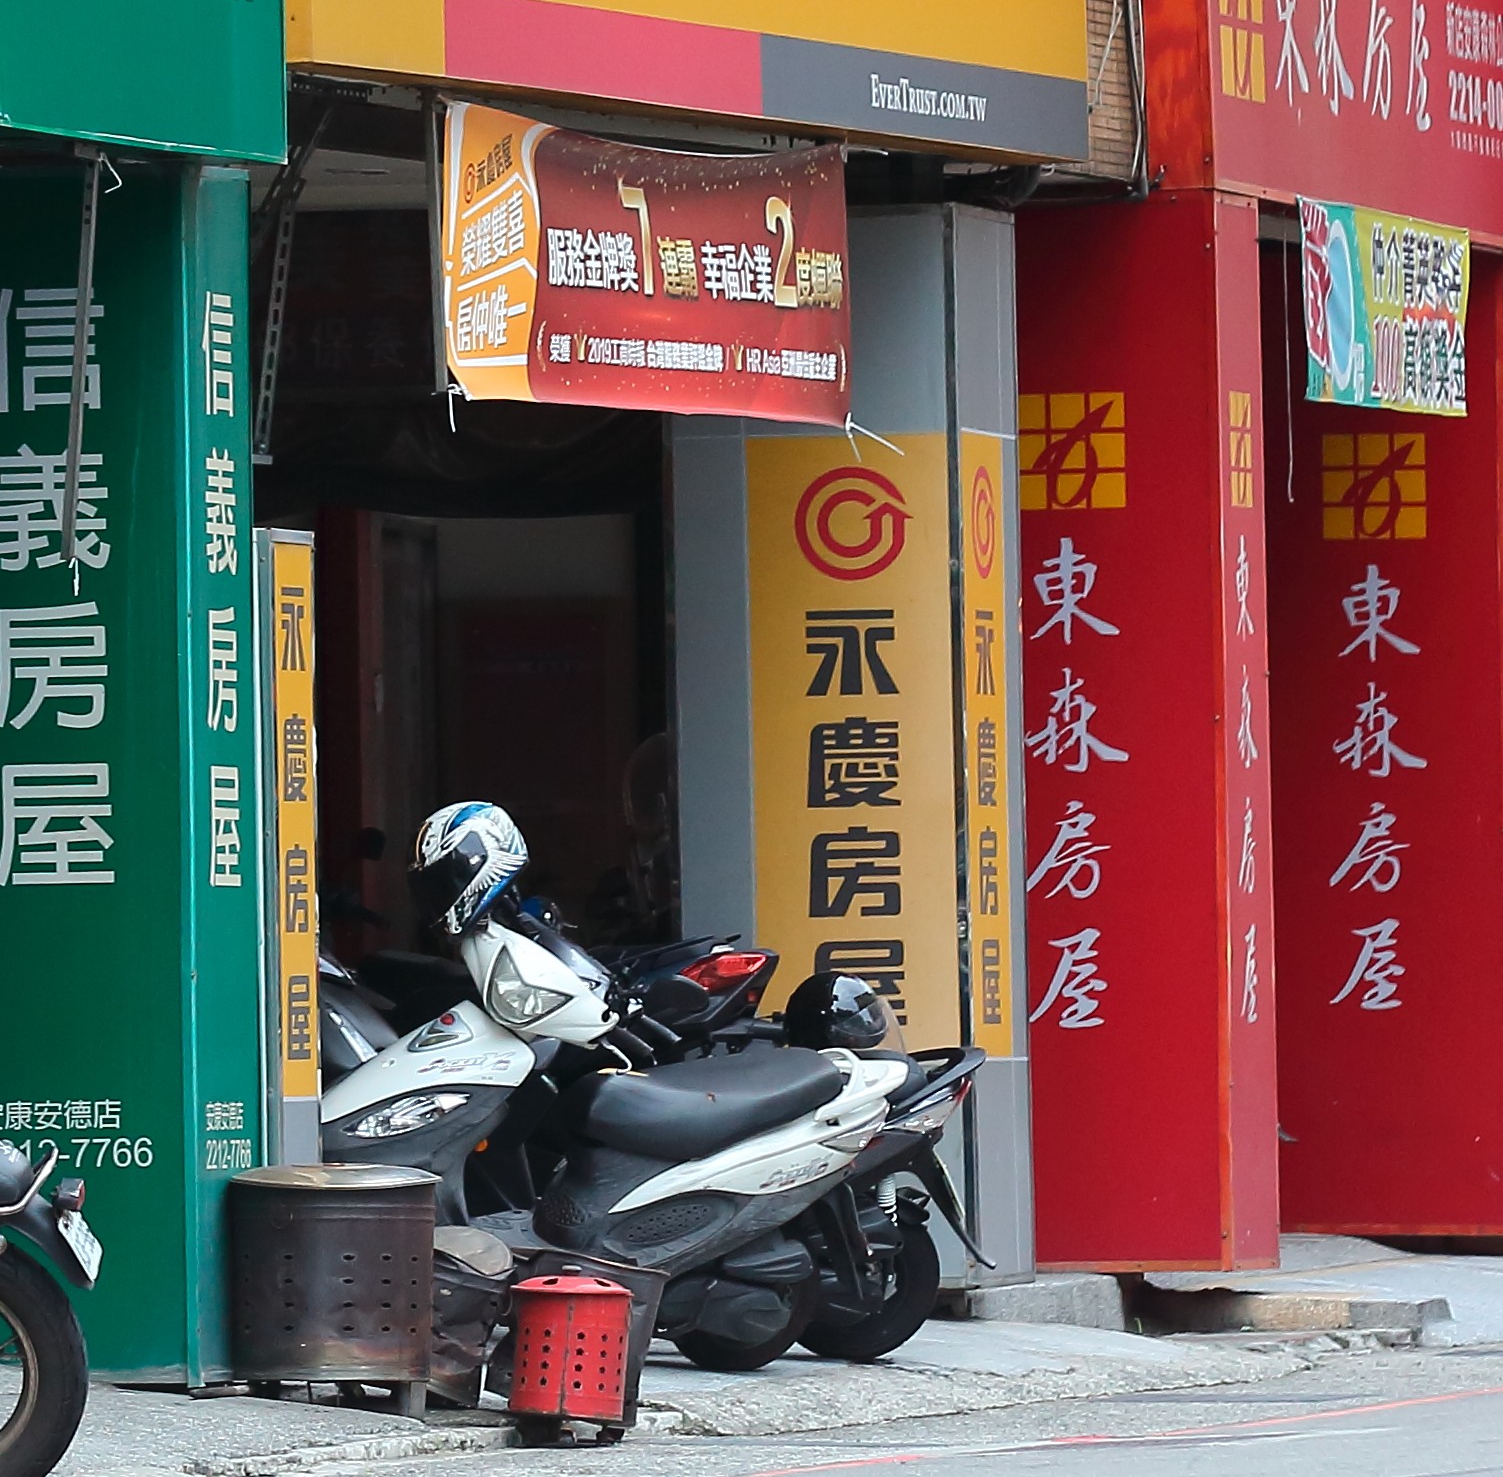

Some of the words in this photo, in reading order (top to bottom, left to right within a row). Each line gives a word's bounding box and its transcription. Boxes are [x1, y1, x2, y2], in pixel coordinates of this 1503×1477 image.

[457, 286, 527, 354] 房仲唯一
[202, 291, 242, 887] 信義房屋
[1022, 537, 1129, 1030] 東森房屋
[1233, 533, 1258, 1023] 東森房屋
[1329, 564, 1428, 1011] 東森房屋
[280, 586, 312, 1060] 永慶房屋
[974, 610, 1003, 1024] 永慶房屋
[206, 1101, 244, 1132] 安康安德店
[206, 1139, 251, 1170] 2212-7766
